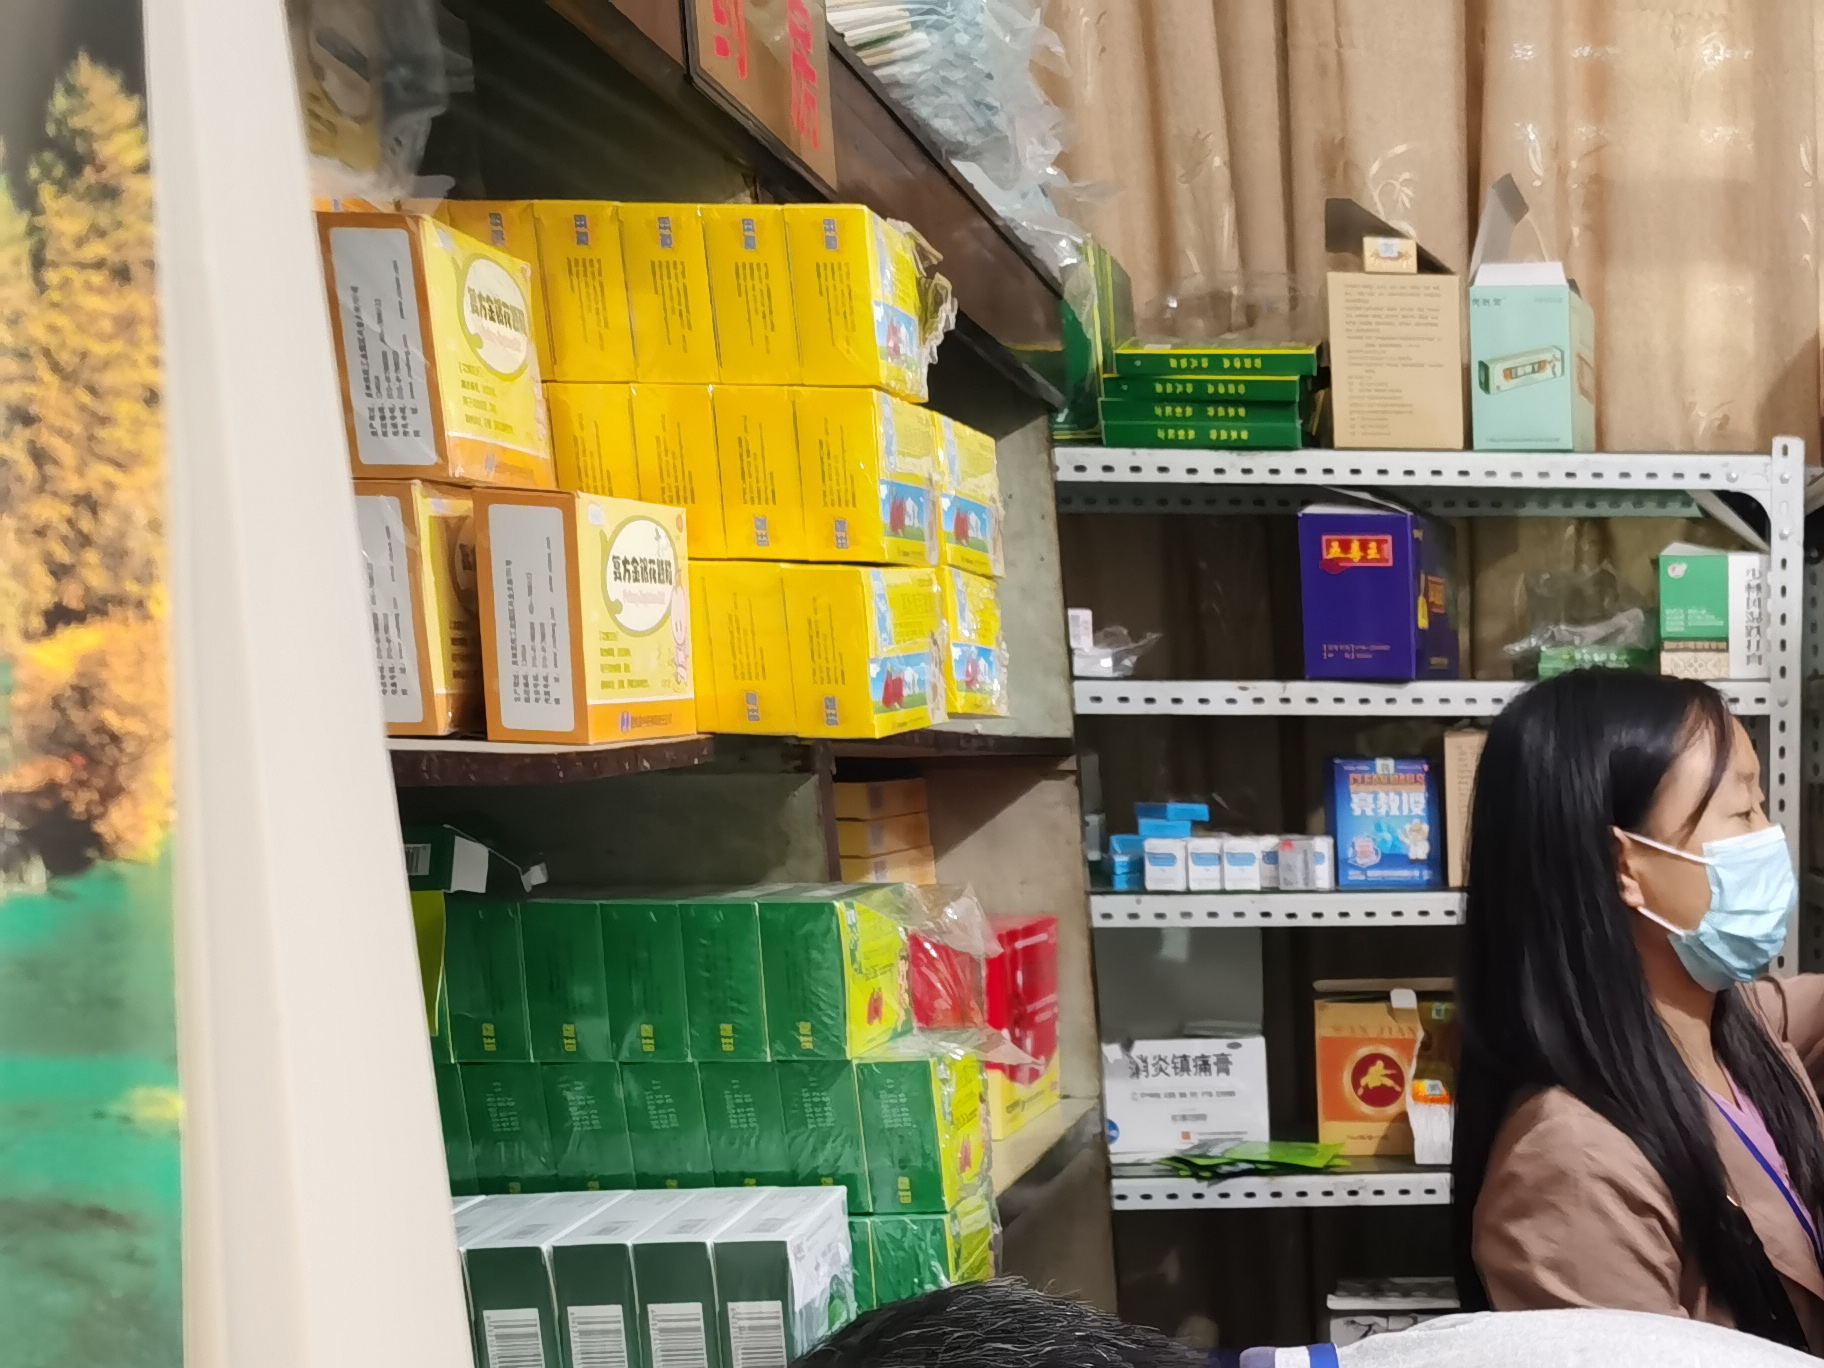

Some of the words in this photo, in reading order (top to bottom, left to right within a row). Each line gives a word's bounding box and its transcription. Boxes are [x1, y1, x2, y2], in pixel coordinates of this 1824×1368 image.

[1129, 1052, 1233, 1079] 消炎镇痛膏
